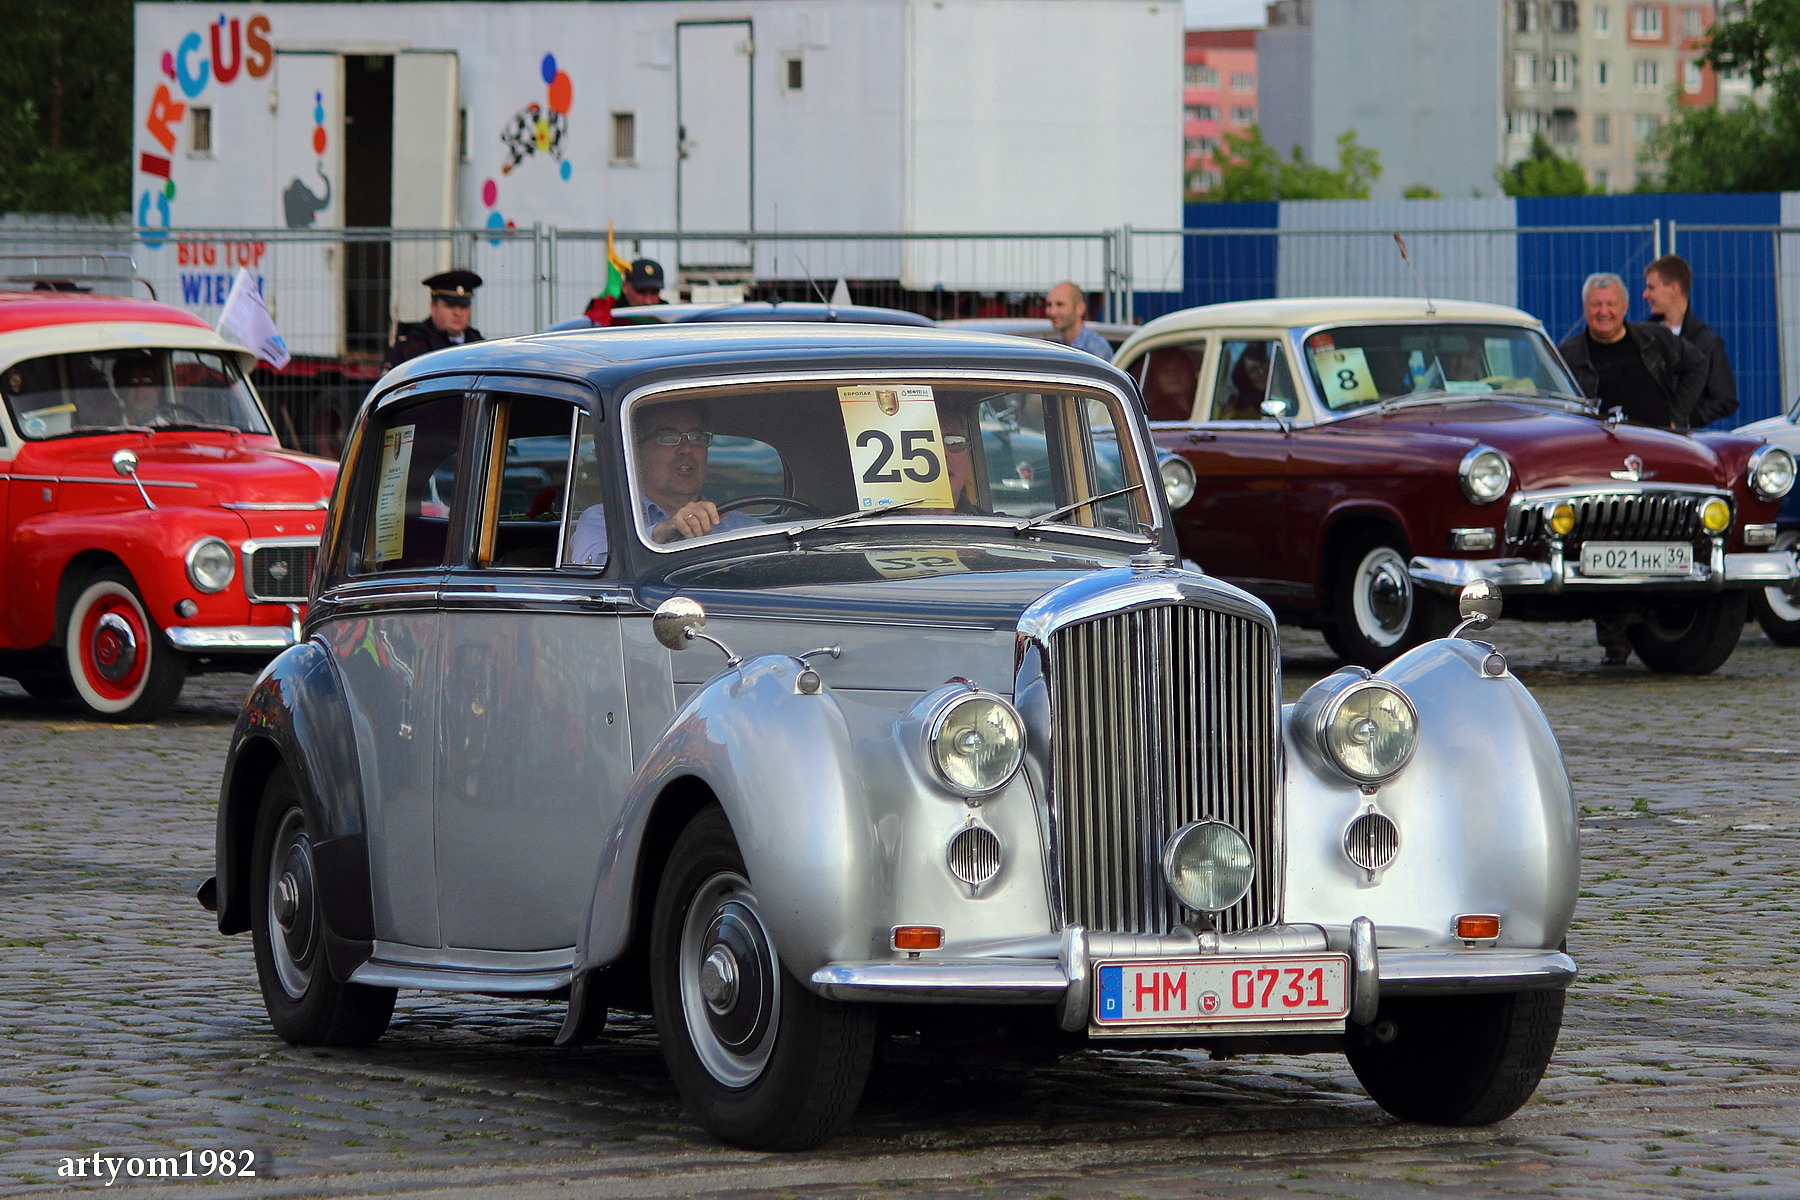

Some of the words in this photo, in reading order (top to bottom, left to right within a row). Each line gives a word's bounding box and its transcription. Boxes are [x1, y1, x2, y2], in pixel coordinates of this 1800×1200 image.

[138, 14, 272, 250] CIRCUS
[178, 233, 216, 267] BIG
[223, 233, 265, 268] TOP
[1337, 370, 1359, 390] 8
[856, 430, 941, 483] 25
[1667, 548, 1684, 563] 39
[1106, 999, 1115, 1010] D
[1135, 971, 1187, 1012] HM
[1231, 967, 1329, 1009] 0731
